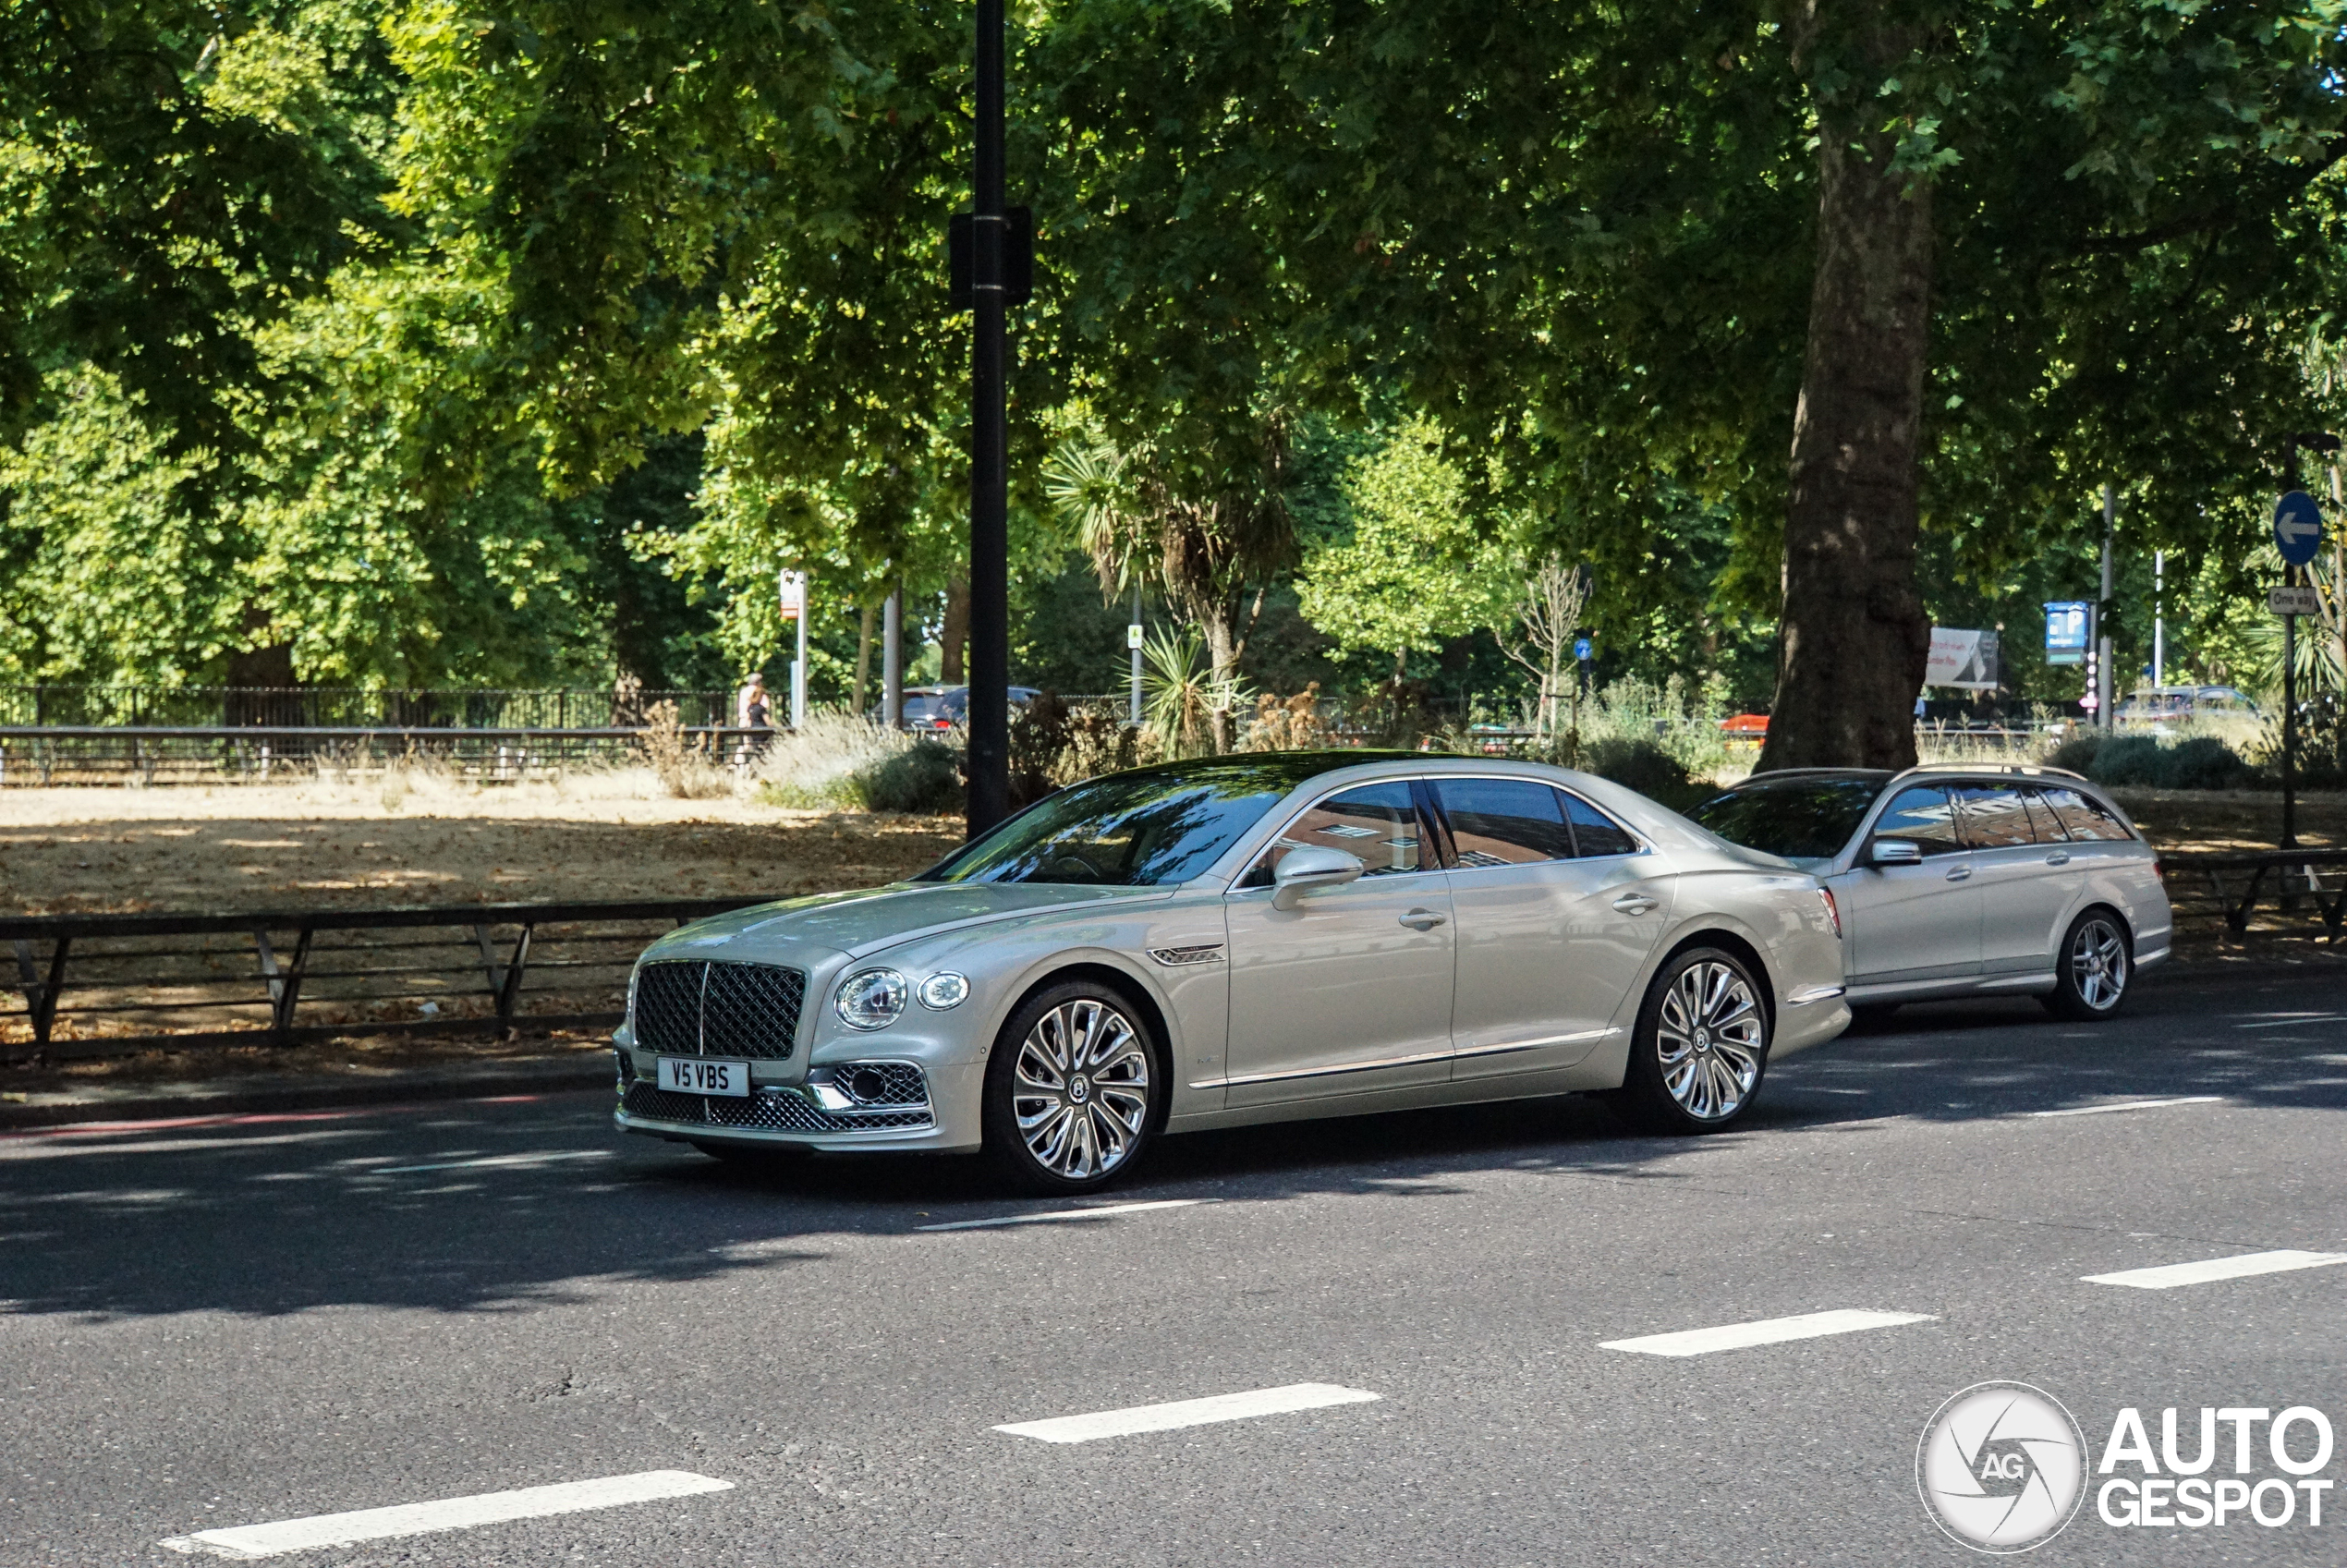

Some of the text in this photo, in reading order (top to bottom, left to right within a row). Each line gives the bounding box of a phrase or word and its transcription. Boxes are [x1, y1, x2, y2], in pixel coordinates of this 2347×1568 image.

[2273, 592, 2313, 607] One way
[2067, 610, 2084, 635] P
[672, 1062, 729, 1090] V5 VBS
[1073, 1082, 1084, 1097] B
